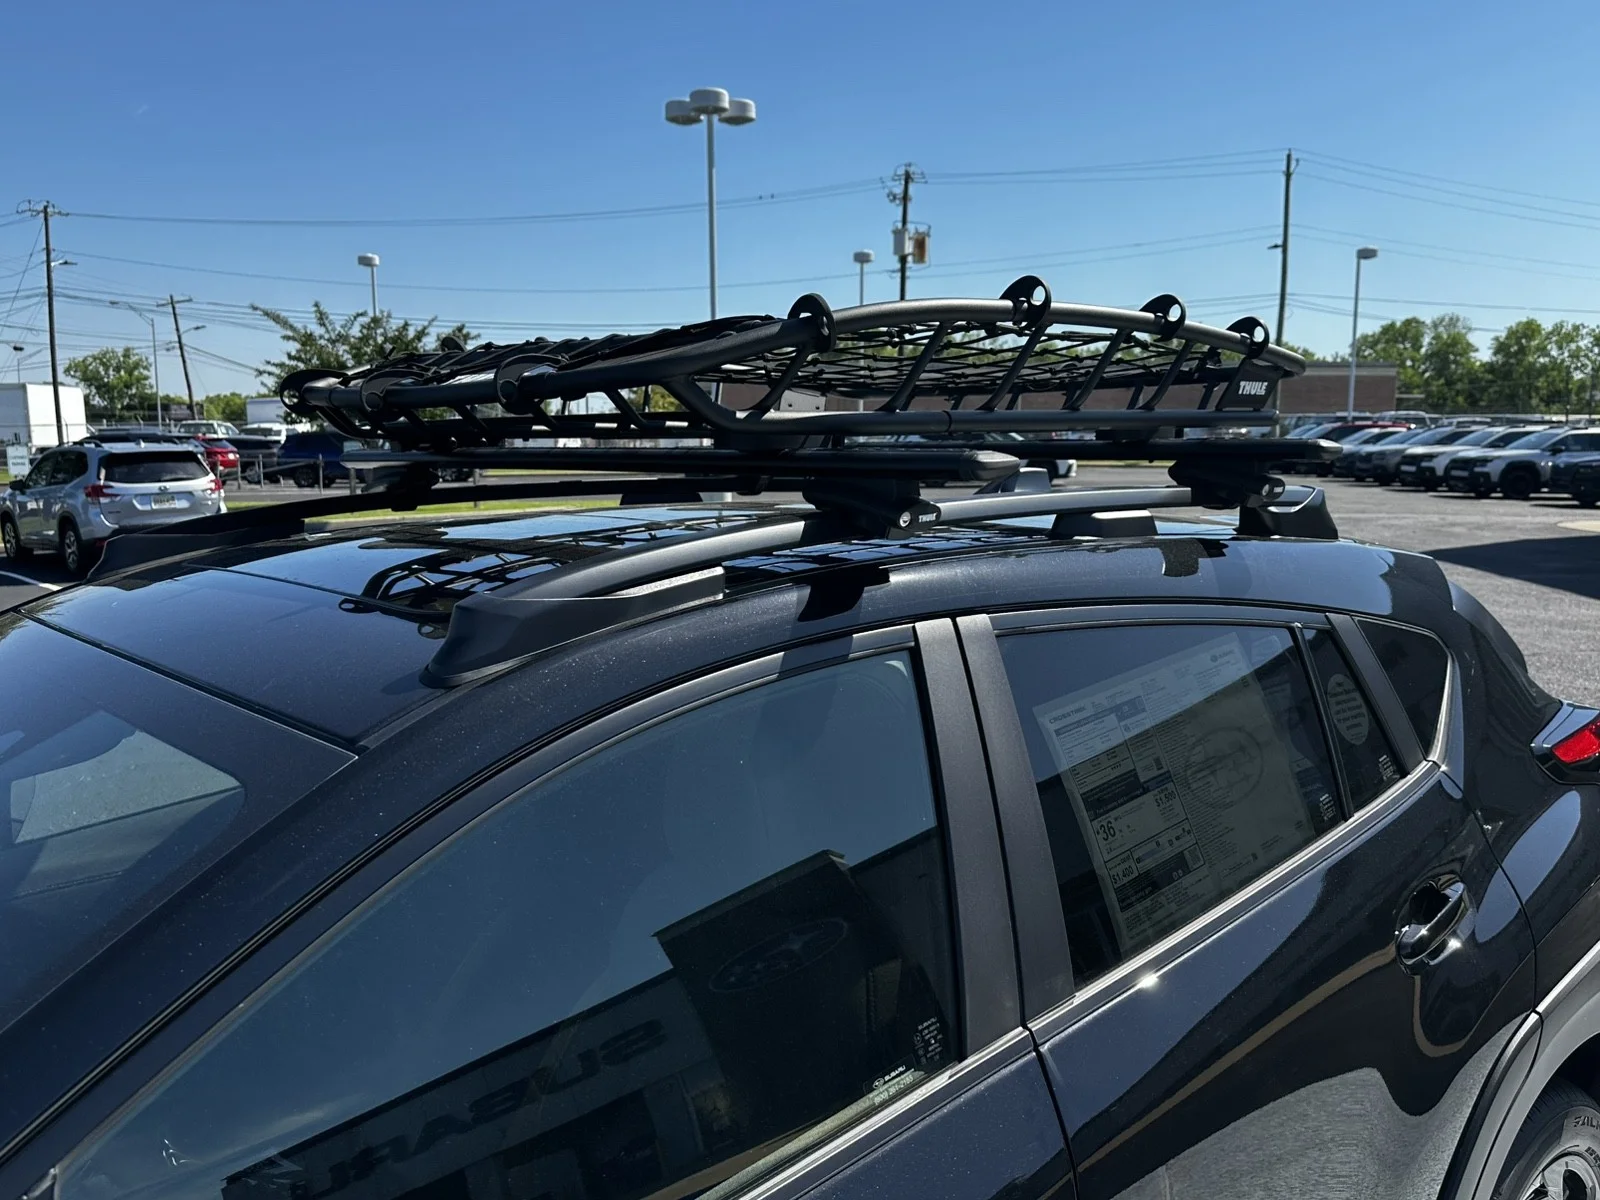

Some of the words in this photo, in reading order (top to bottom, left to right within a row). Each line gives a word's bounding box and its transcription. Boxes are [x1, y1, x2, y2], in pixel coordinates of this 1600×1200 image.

[1238, 381, 1268, 395] THULE
[1100, 820, 1116, 841] 36
[884, 1065, 906, 1081] SUBARU
